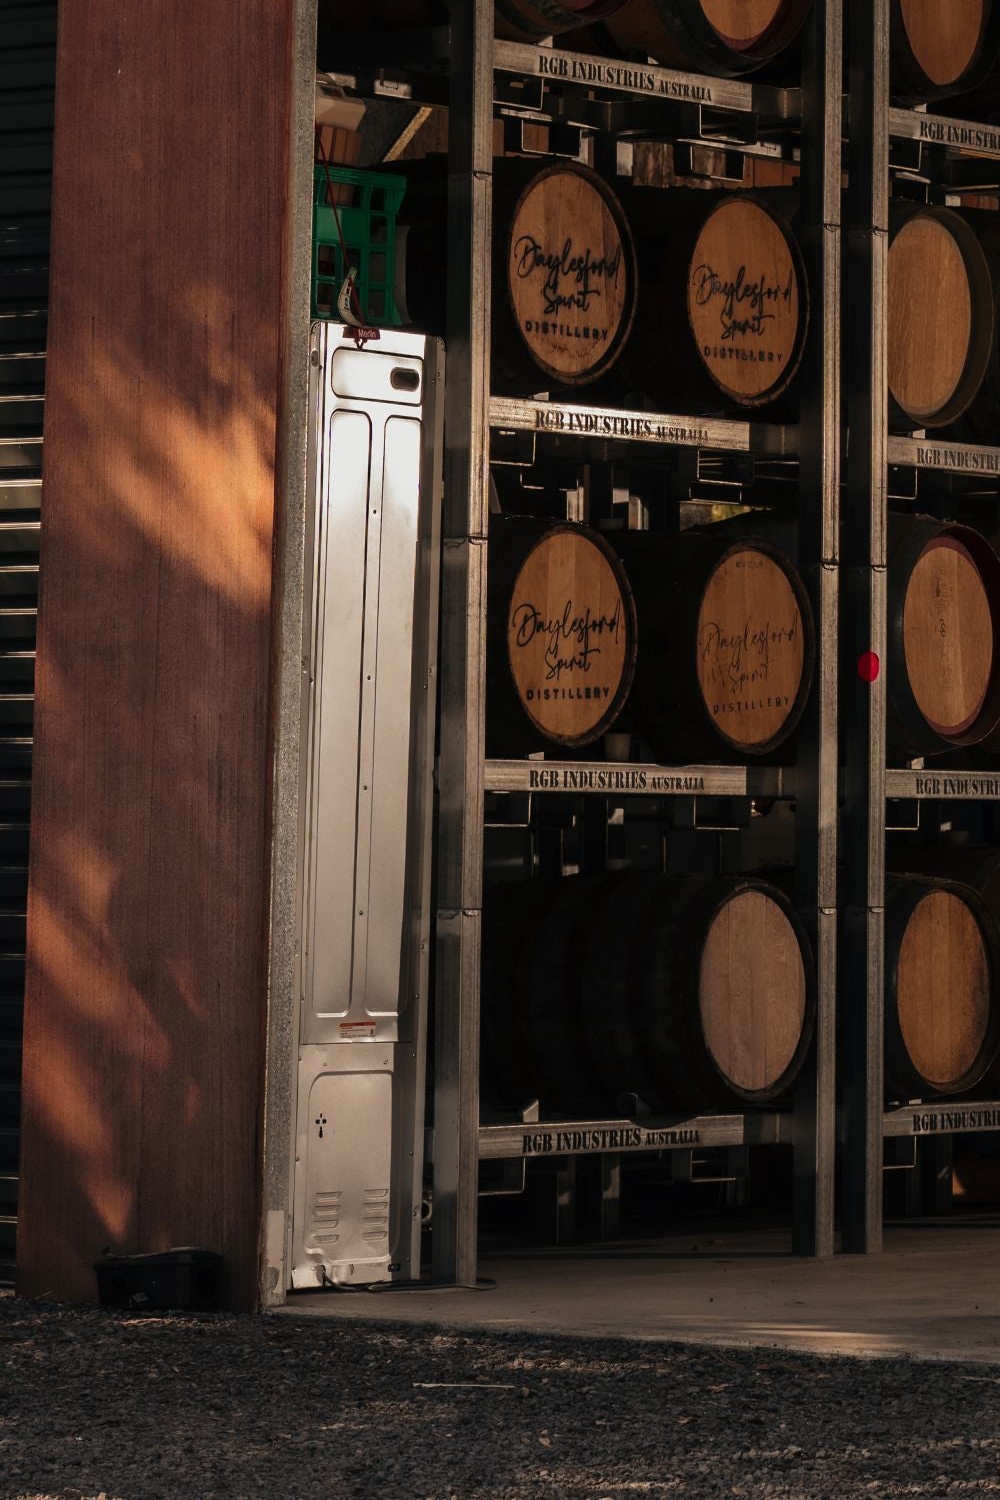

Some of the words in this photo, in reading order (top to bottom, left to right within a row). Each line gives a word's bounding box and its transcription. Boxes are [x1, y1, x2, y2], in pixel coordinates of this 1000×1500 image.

[538, 55, 568, 76] RGB
[572, 61, 655, 91] INDUSTRIES
[658, 80, 713, 102] AUSTRALIA
[919, 121, 944, 140] RGB
[514, 236, 622, 291] Daylesford
[543, 284, 600, 315] Spirit
[692, 265, 793, 316] Daylesford
[525, 321, 609, 341] DISTILLERY
[720, 312, 776, 340] Spirit
[703, 346, 784, 364] DISTILLERY
[535, 411, 564, 431] RGB
[568, 414, 652, 439] INDUSTRIES
[655, 426, 709, 443] AUSTRALIA
[917, 448, 941, 465] RGB
[512, 599, 621, 657] Daylesford
[545, 648, 601, 681] Spirit
[526, 686, 610, 700] DISTILLERY
[713, 696, 790, 715] DISTILLERY
[529, 770, 559, 789] RGB
[563, 771, 647, 790] INDUSTRIES
[651, 776, 705, 790] AUSTRALIA
[915, 778, 940, 795] RGB
[913, 1114, 937, 1132] RGB
[522, 1134, 552, 1153] RGB
[557, 1128, 641, 1150] INDUSTRIES
[645, 1130, 700, 1146] AUSTRALIA
